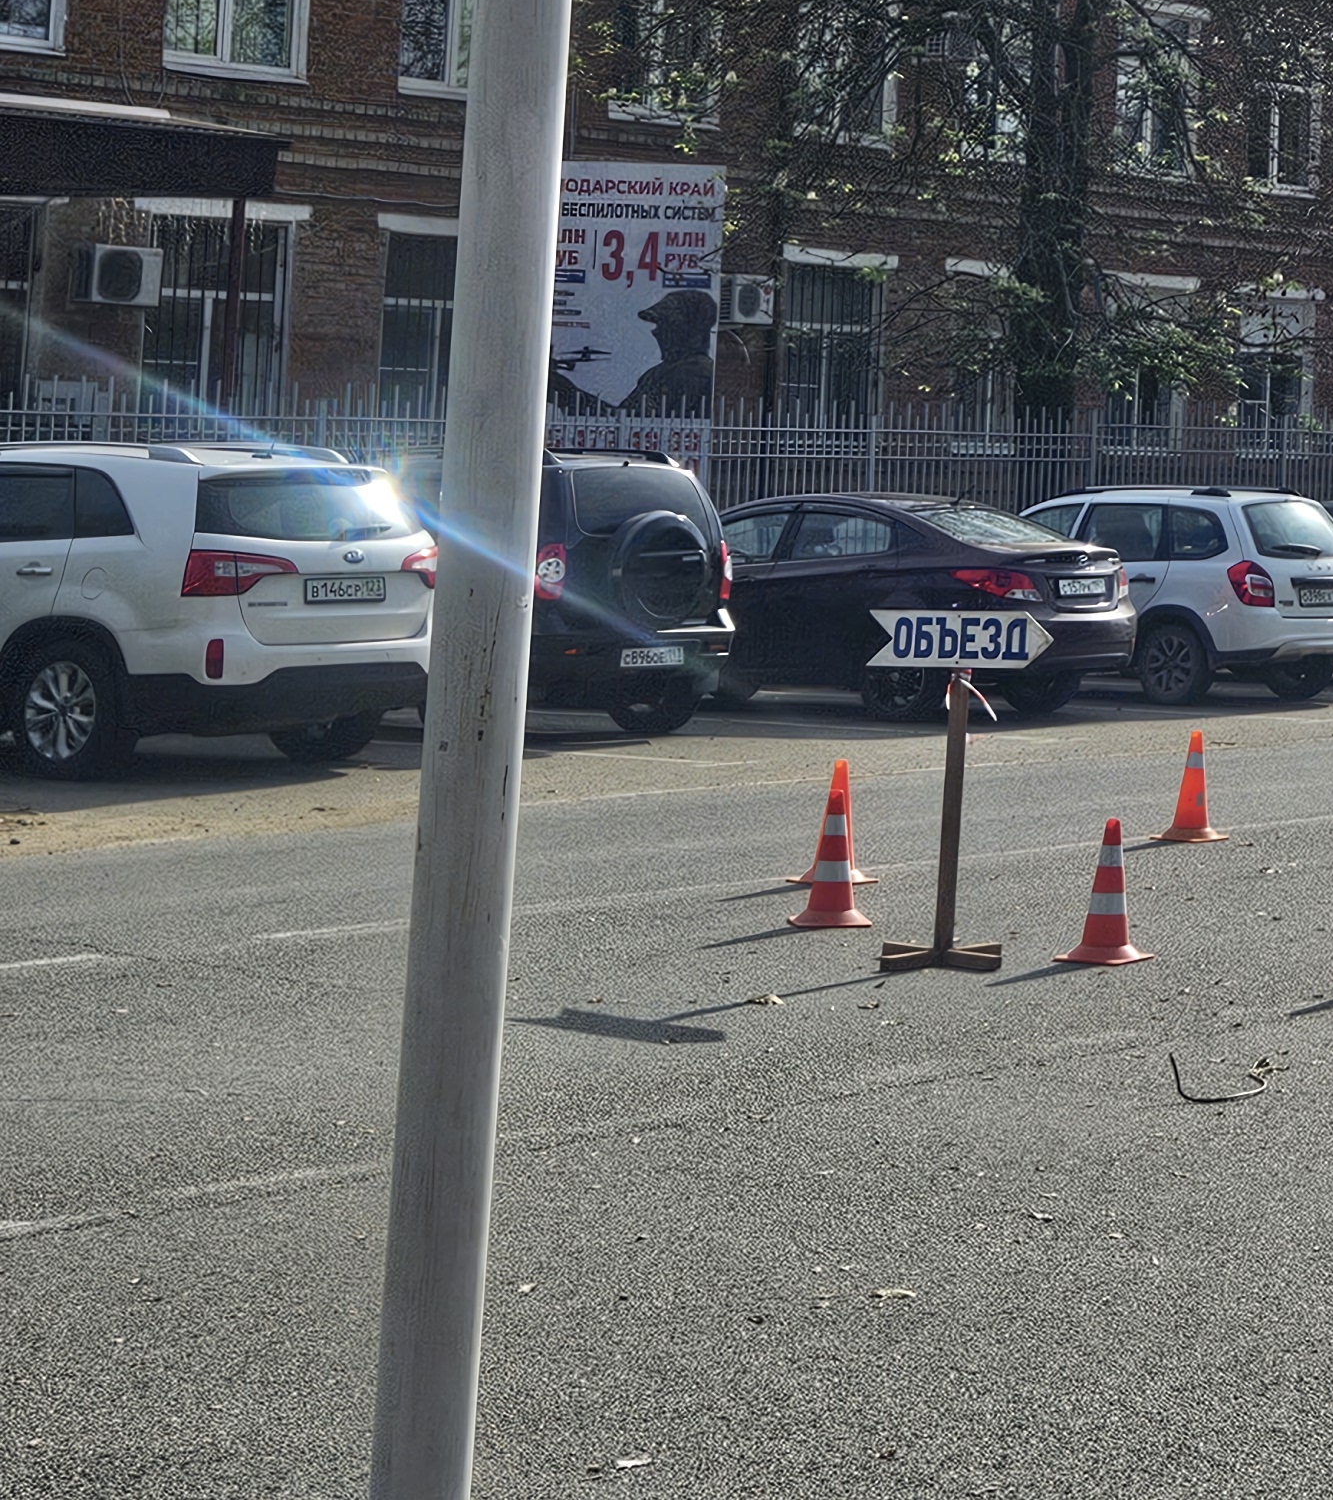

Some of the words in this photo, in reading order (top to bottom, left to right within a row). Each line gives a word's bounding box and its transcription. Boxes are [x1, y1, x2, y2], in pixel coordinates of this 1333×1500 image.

[669, 179, 715, 197] КРАЙ
[561, 202, 660, 220] БЕСПИЛОТНЫХ
[664, 204, 716, 221] СИСТЕМ
[557, 228, 586, 244] ЛН
[666, 231, 705, 248] МЛН
[556, 250, 579, 267] УБ
[601, 229, 660, 289] 3,4
[893, 616, 1029, 661] ОБЪЕЗД
